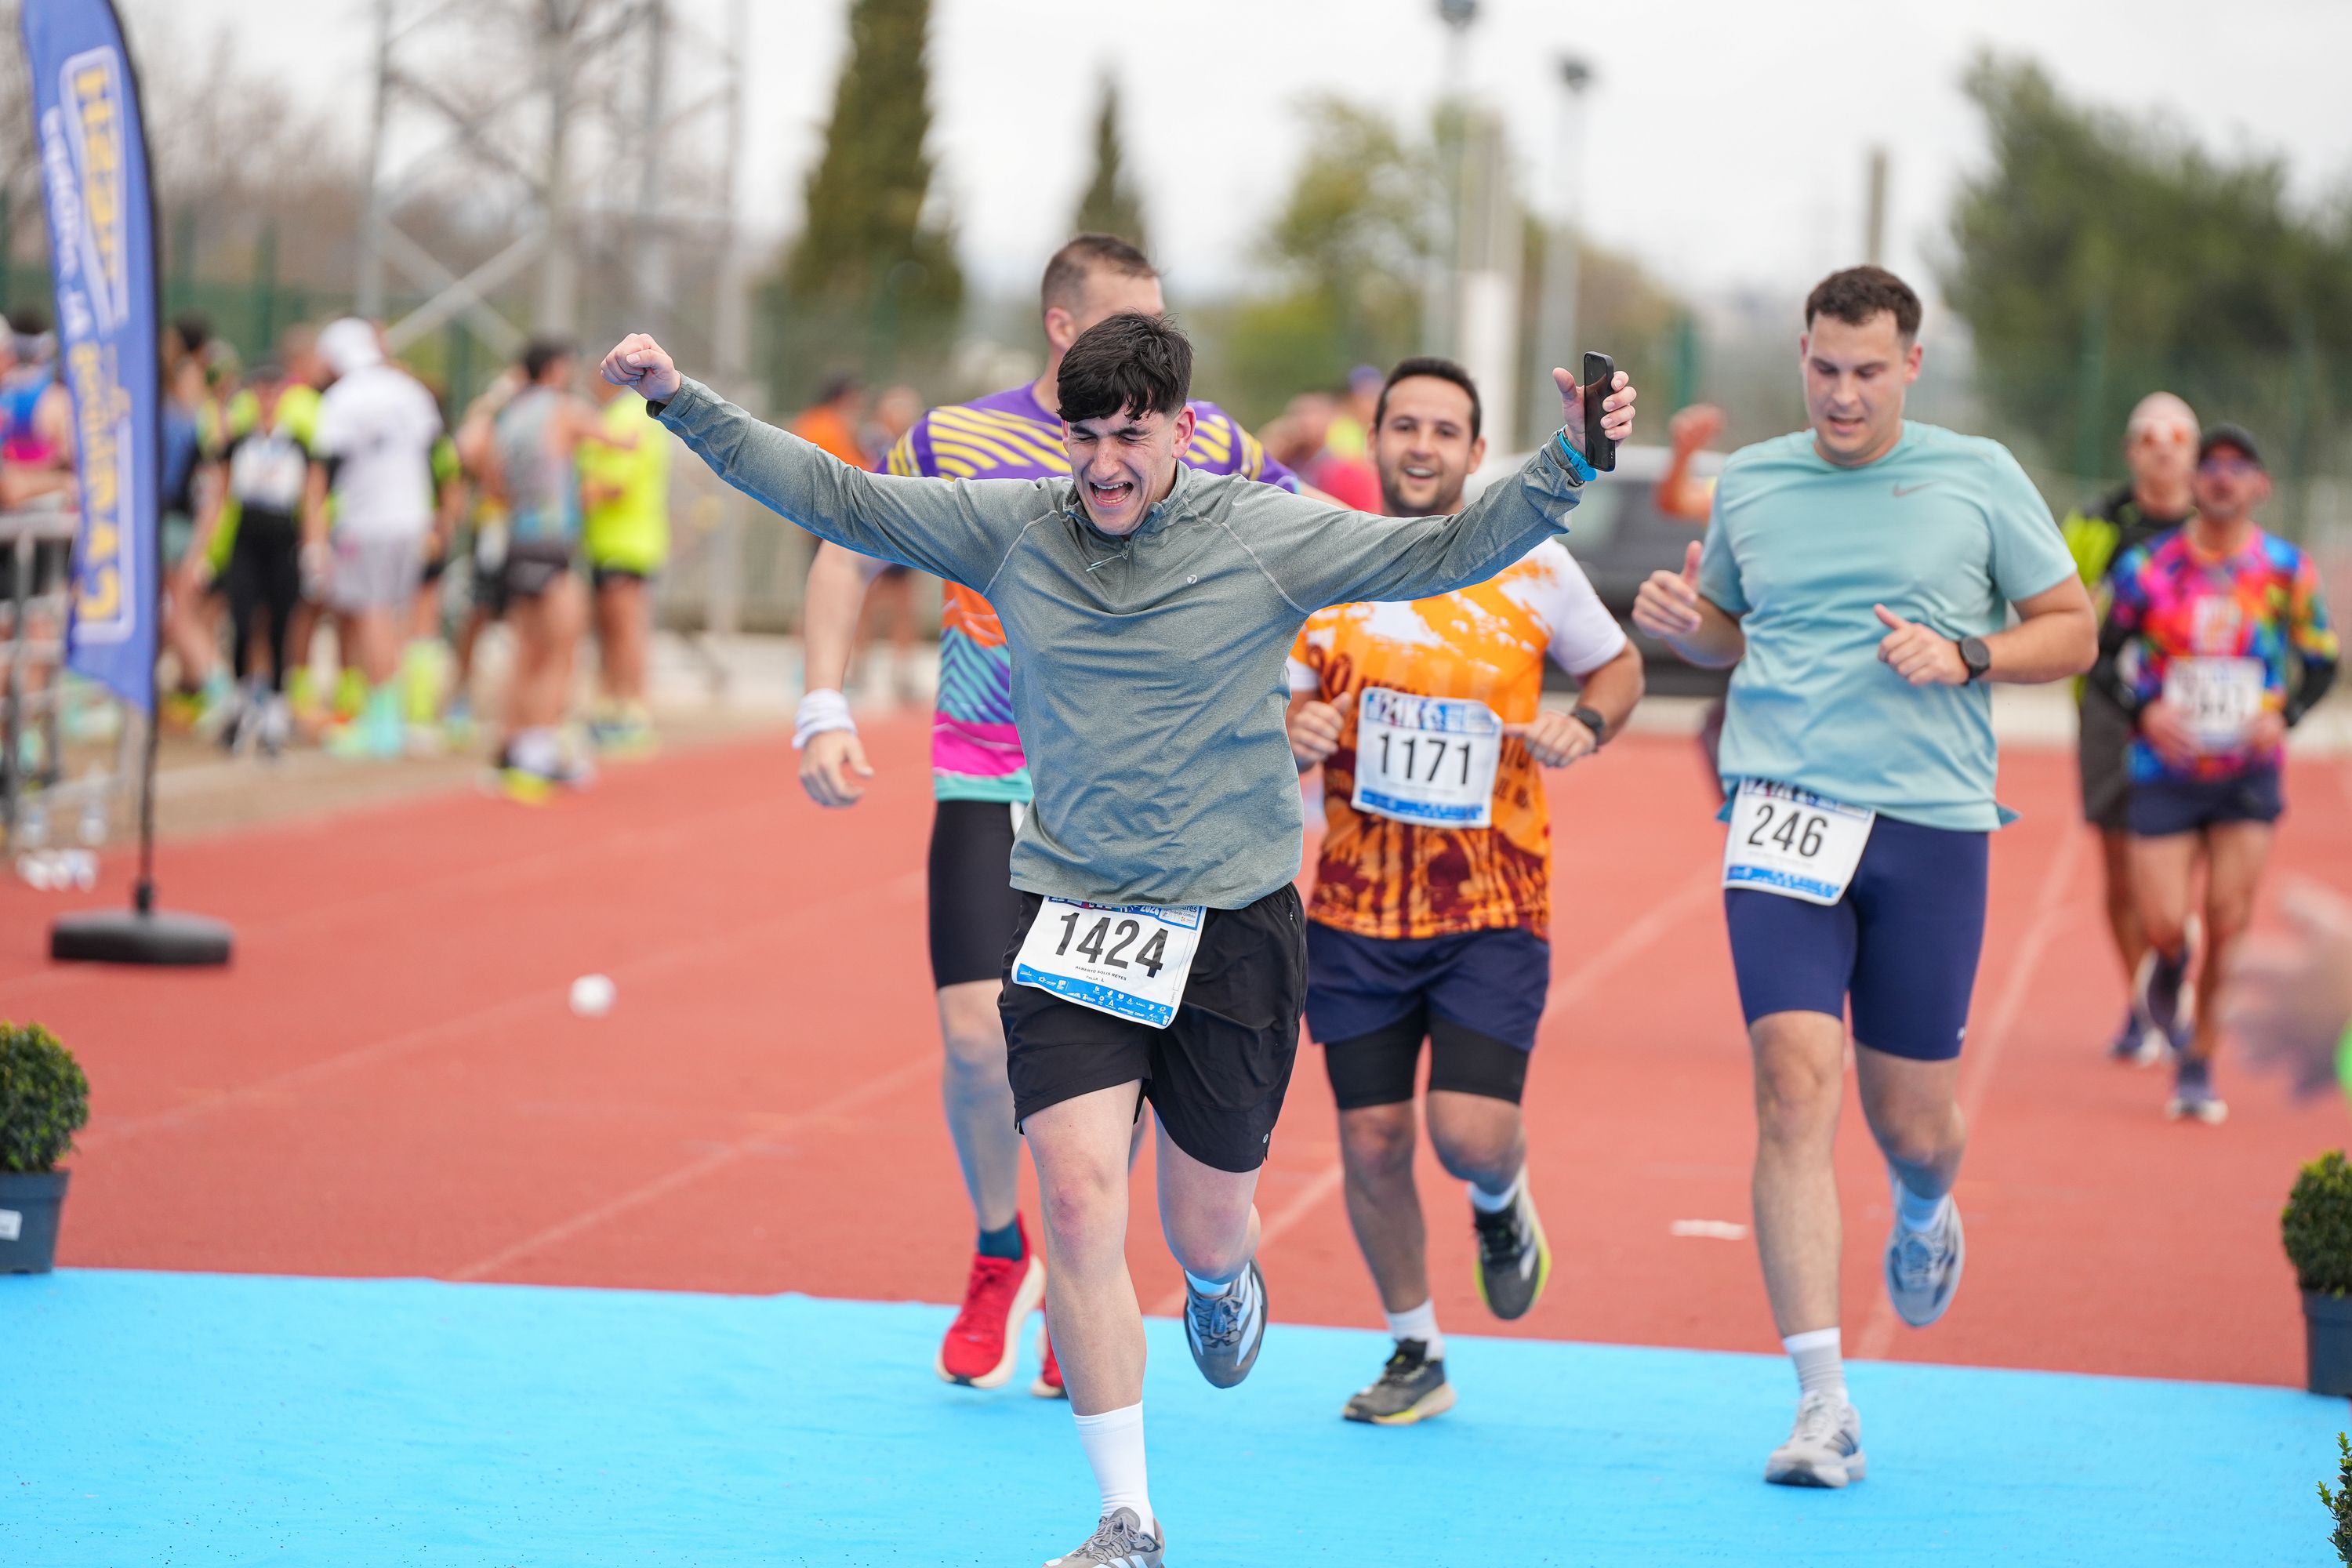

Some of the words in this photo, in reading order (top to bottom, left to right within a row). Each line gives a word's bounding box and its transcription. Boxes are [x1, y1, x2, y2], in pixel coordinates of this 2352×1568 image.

[1379, 732, 1471, 786] 1171
[1747, 802, 1829, 858] 246
[1054, 911, 1170, 978] 1424
